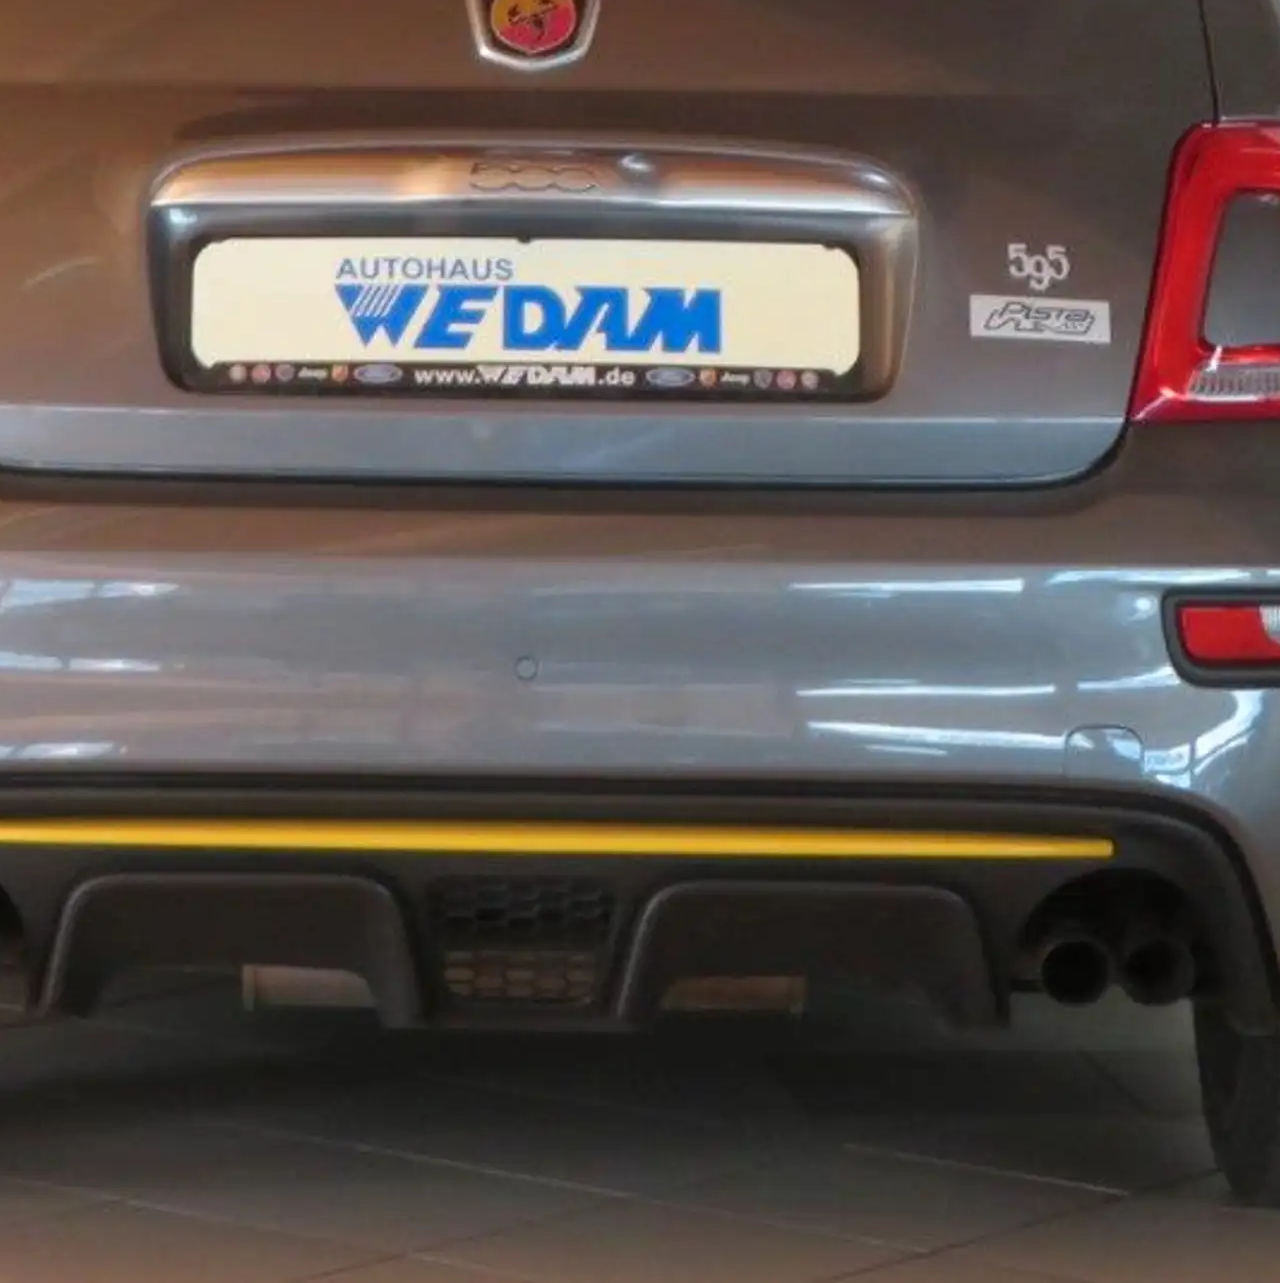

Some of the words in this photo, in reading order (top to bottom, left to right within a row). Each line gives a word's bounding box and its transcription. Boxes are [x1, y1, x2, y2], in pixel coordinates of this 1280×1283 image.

[336, 258, 513, 281] AUTOHAUS
[1008, 243, 1070, 290] 595
[335, 285, 720, 354] WEDAM
